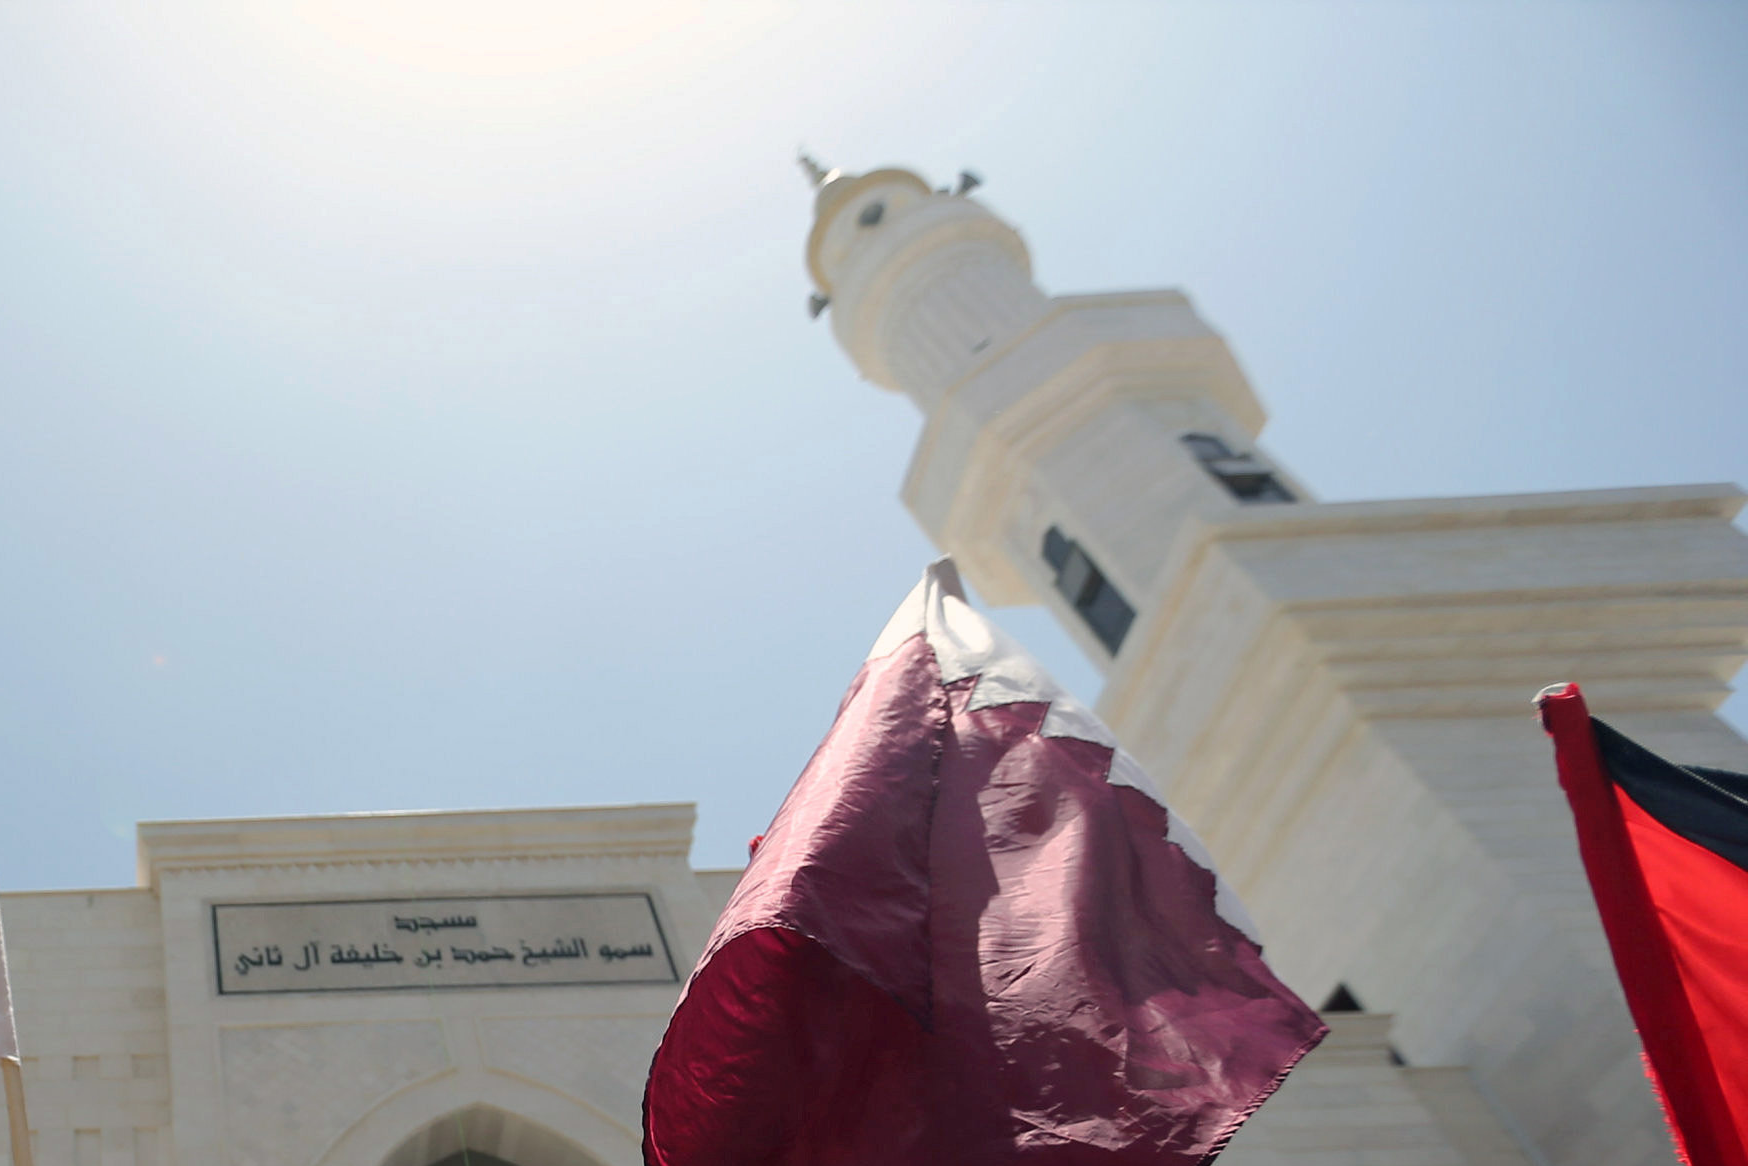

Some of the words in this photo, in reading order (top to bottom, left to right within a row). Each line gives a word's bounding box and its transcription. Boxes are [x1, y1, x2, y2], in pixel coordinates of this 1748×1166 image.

[394, 915, 478, 935] مسجد
[330, 941, 404, 968] خليفة
[413, 947, 443, 969] بن
[450, 945, 516, 965] حمد
[520, 937, 589, 967] الشيخ
[598, 943, 654, 963] سمو
